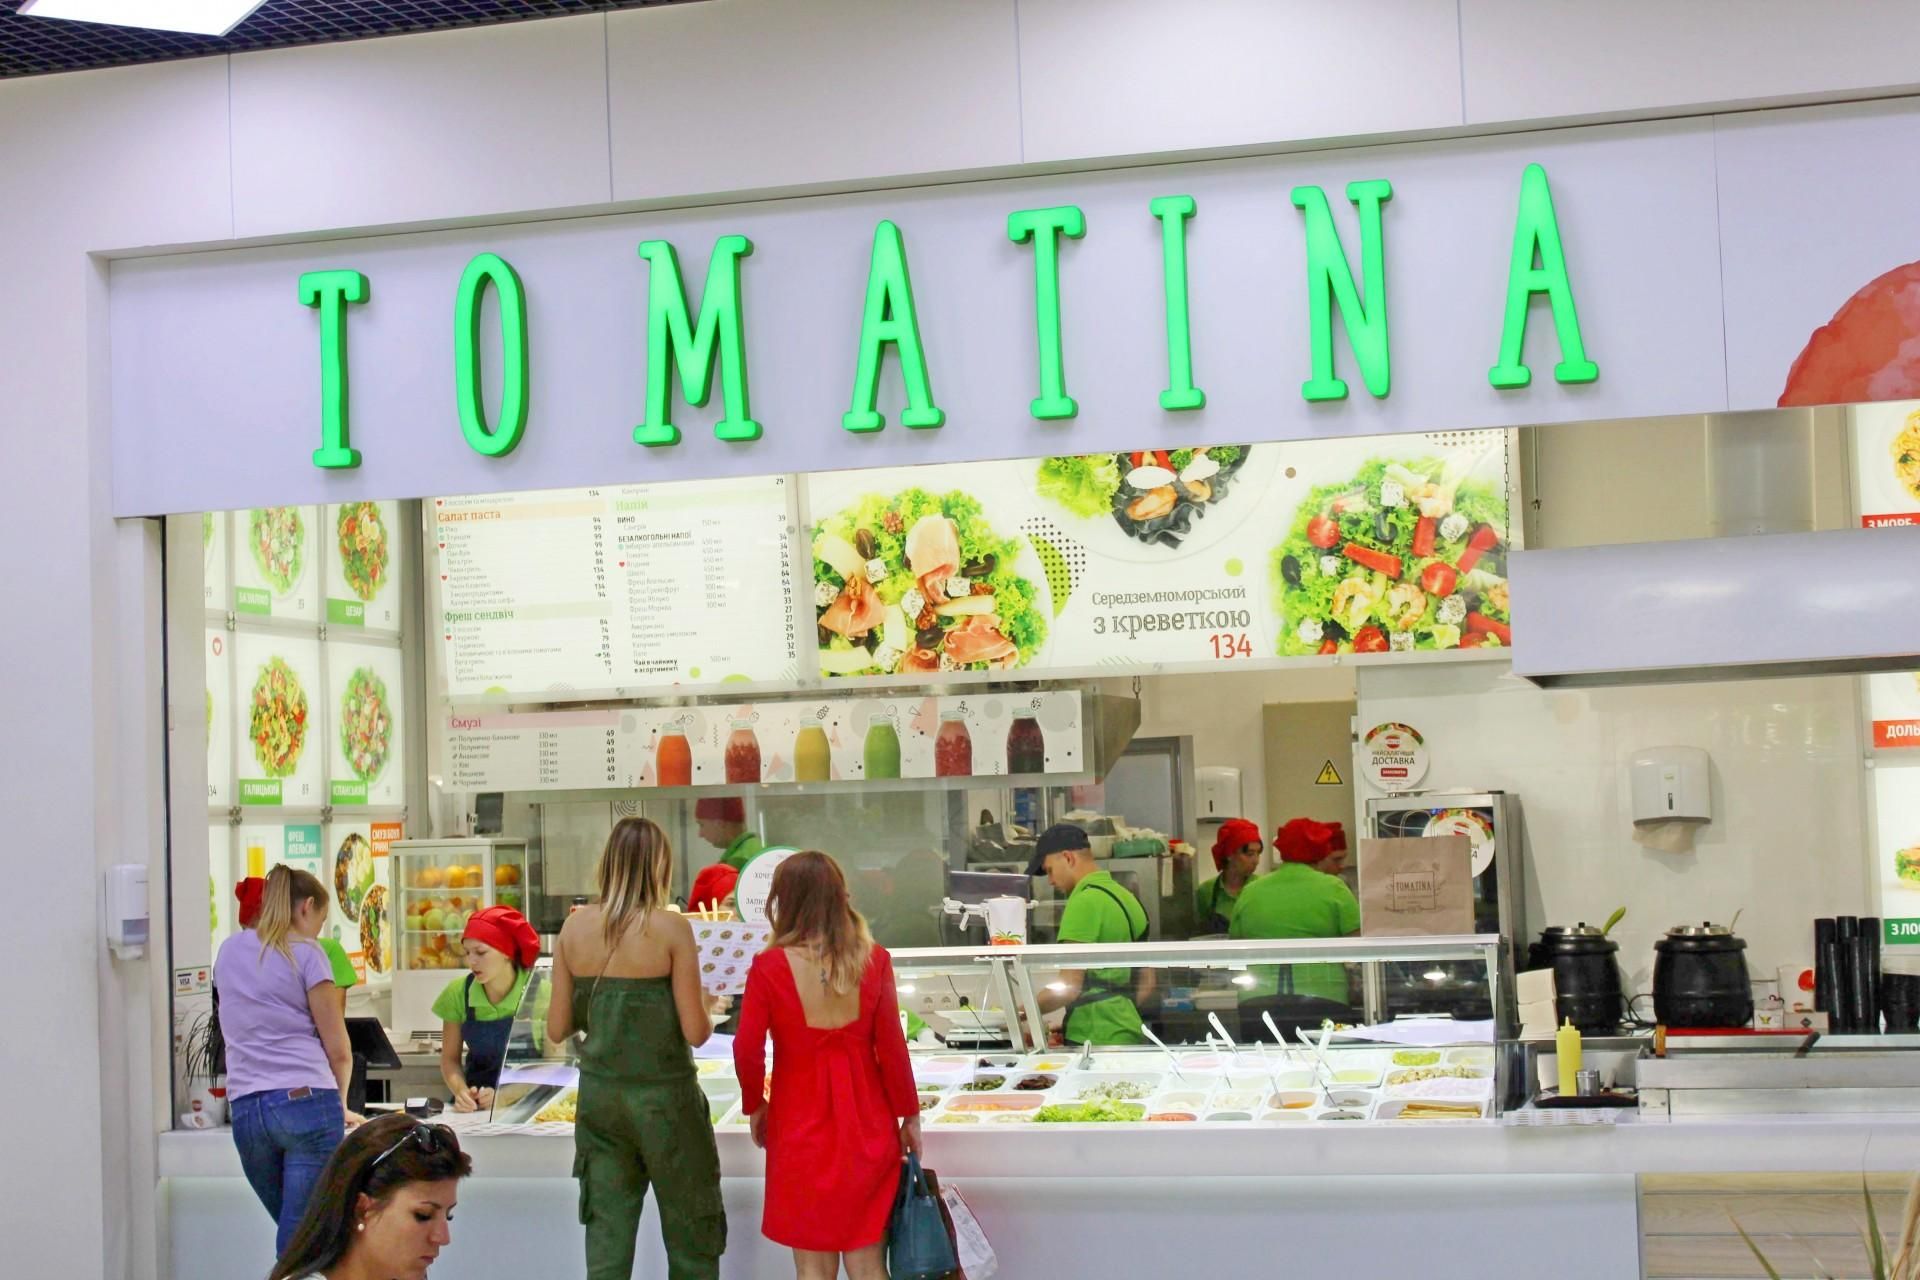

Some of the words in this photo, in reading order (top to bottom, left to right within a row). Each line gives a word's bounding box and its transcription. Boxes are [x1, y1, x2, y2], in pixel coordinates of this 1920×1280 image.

[299, 163, 1599, 469] TOMATINA
[776, 478, 784, 486] 29
[438, 512, 468, 523] Салат
[471, 510, 502, 521] паста
[617, 515, 636, 524] ВИНО
[777, 514, 786, 522] 39
[618, 532, 670, 543] БЕЗАЛКОГОЛЬНІ
[783, 587, 791, 595] 39
[784, 596, 792, 604] 33
[1092, 585, 1246, 609] Середземноморський
[785, 605, 792, 613] 27
[444, 611, 472, 625] Фреш
[474, 610, 514, 622] сендвіч
[785, 614, 793, 622] 27
[786, 623, 794, 631] 29
[1112, 609, 1251, 640] креветкою
[786, 632, 794, 640] 29
[1209, 632, 1253, 659] 134
[451, 719, 481, 731] Смузі
[606, 729, 615, 737] 49
[606, 738, 615, 746] 49
[606, 747, 615, 755] 49
[606, 756, 615, 764] 49
[1372, 757, 1416, 766] ДОСТАВКА
[606, 765, 615, 773] 49
[607, 774, 616, 782] 49
[244, 782, 280, 797] ГАЛИЦЬКИЙ
[288, 831, 305, 843] ФРЕШ
[288, 843, 317, 856] АПЕЛЬСИН
[1900, 922, 1920, 936] ЛО
